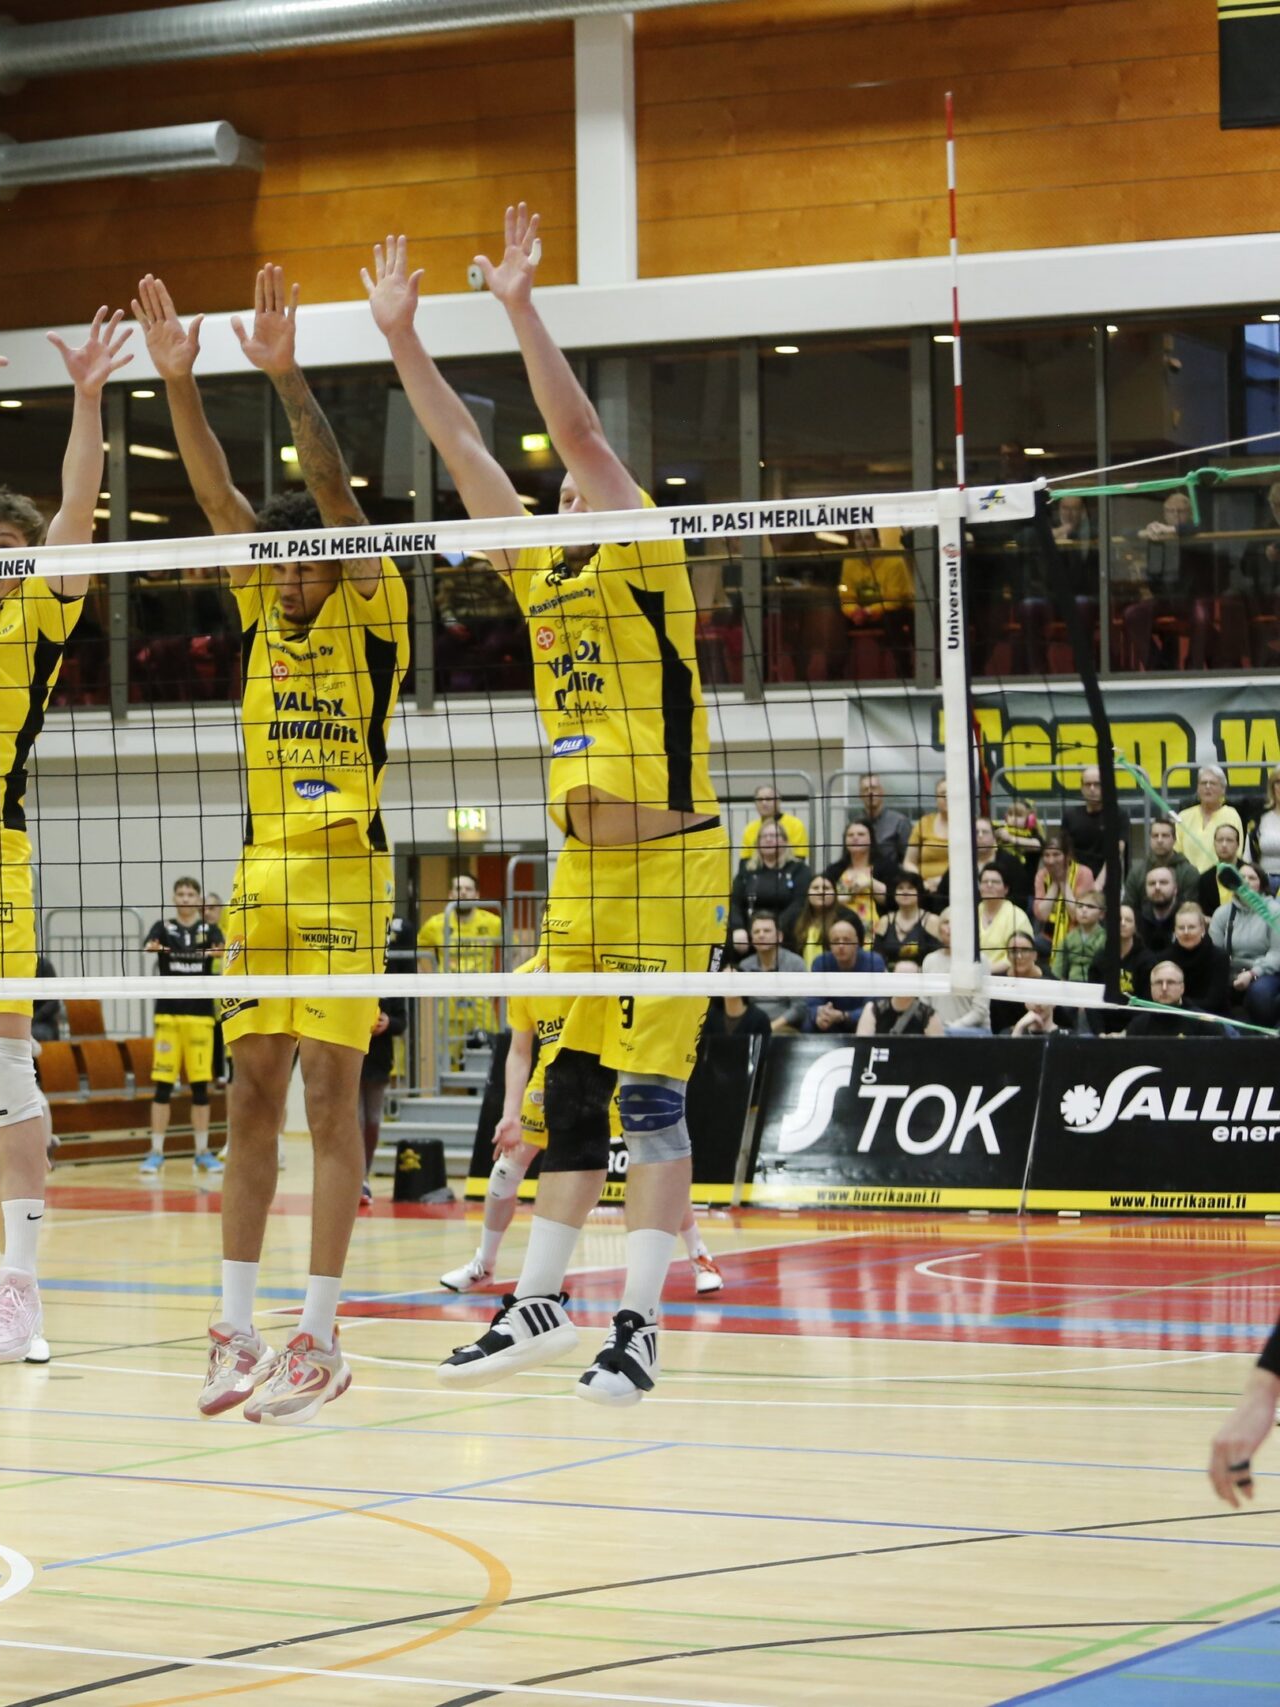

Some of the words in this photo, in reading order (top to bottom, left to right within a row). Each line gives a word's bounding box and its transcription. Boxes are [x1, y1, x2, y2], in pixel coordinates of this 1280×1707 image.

[669, 517, 708, 535] TMI.
[712, 511, 754, 532] PASI
[759, 504, 875, 529] MERILÄINEN
[249, 543, 283, 560] TMI.
[287, 538, 326, 558] PASI
[331, 532, 436, 555] MERILÄINEN
[946, 561, 960, 650] Universal
[340, 935, 353, 945] OY
[817, 1189, 941, 1204] www.hurrikaani.fi
[1110, 1193, 1247, 1208] www.hurrikaani.fi
